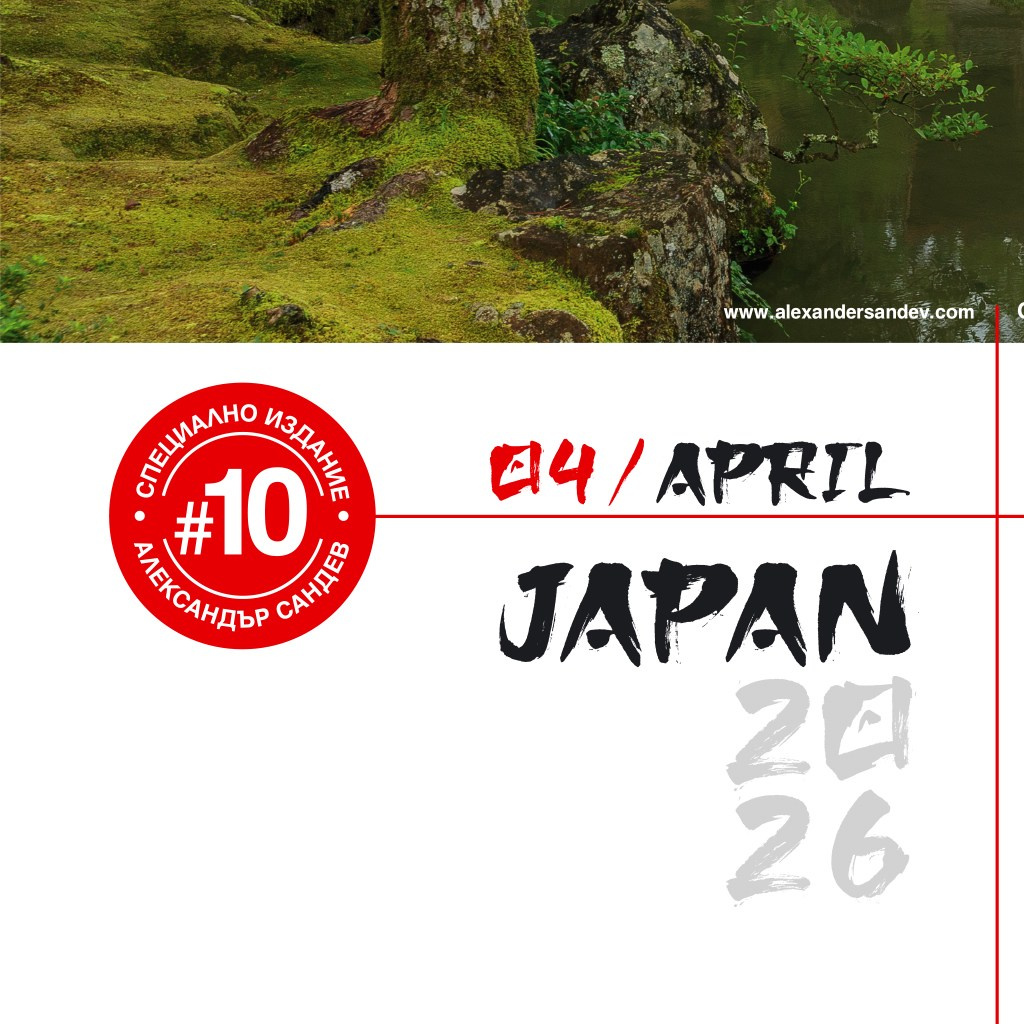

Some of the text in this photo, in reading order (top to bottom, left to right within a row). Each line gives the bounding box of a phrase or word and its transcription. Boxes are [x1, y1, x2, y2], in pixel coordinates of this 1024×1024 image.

[136, 403, 350, 503] СПЕЦИАЛНО ИЗДАНИЕ
[174, 466, 308, 558] #10
[133, 540, 350, 632] АЛЕКСАНДЪР САНДЕВ
[499, 550, 913, 667] JAPAN
[727, 676, 912, 787] 20
[727, 790, 909, 905] 26
